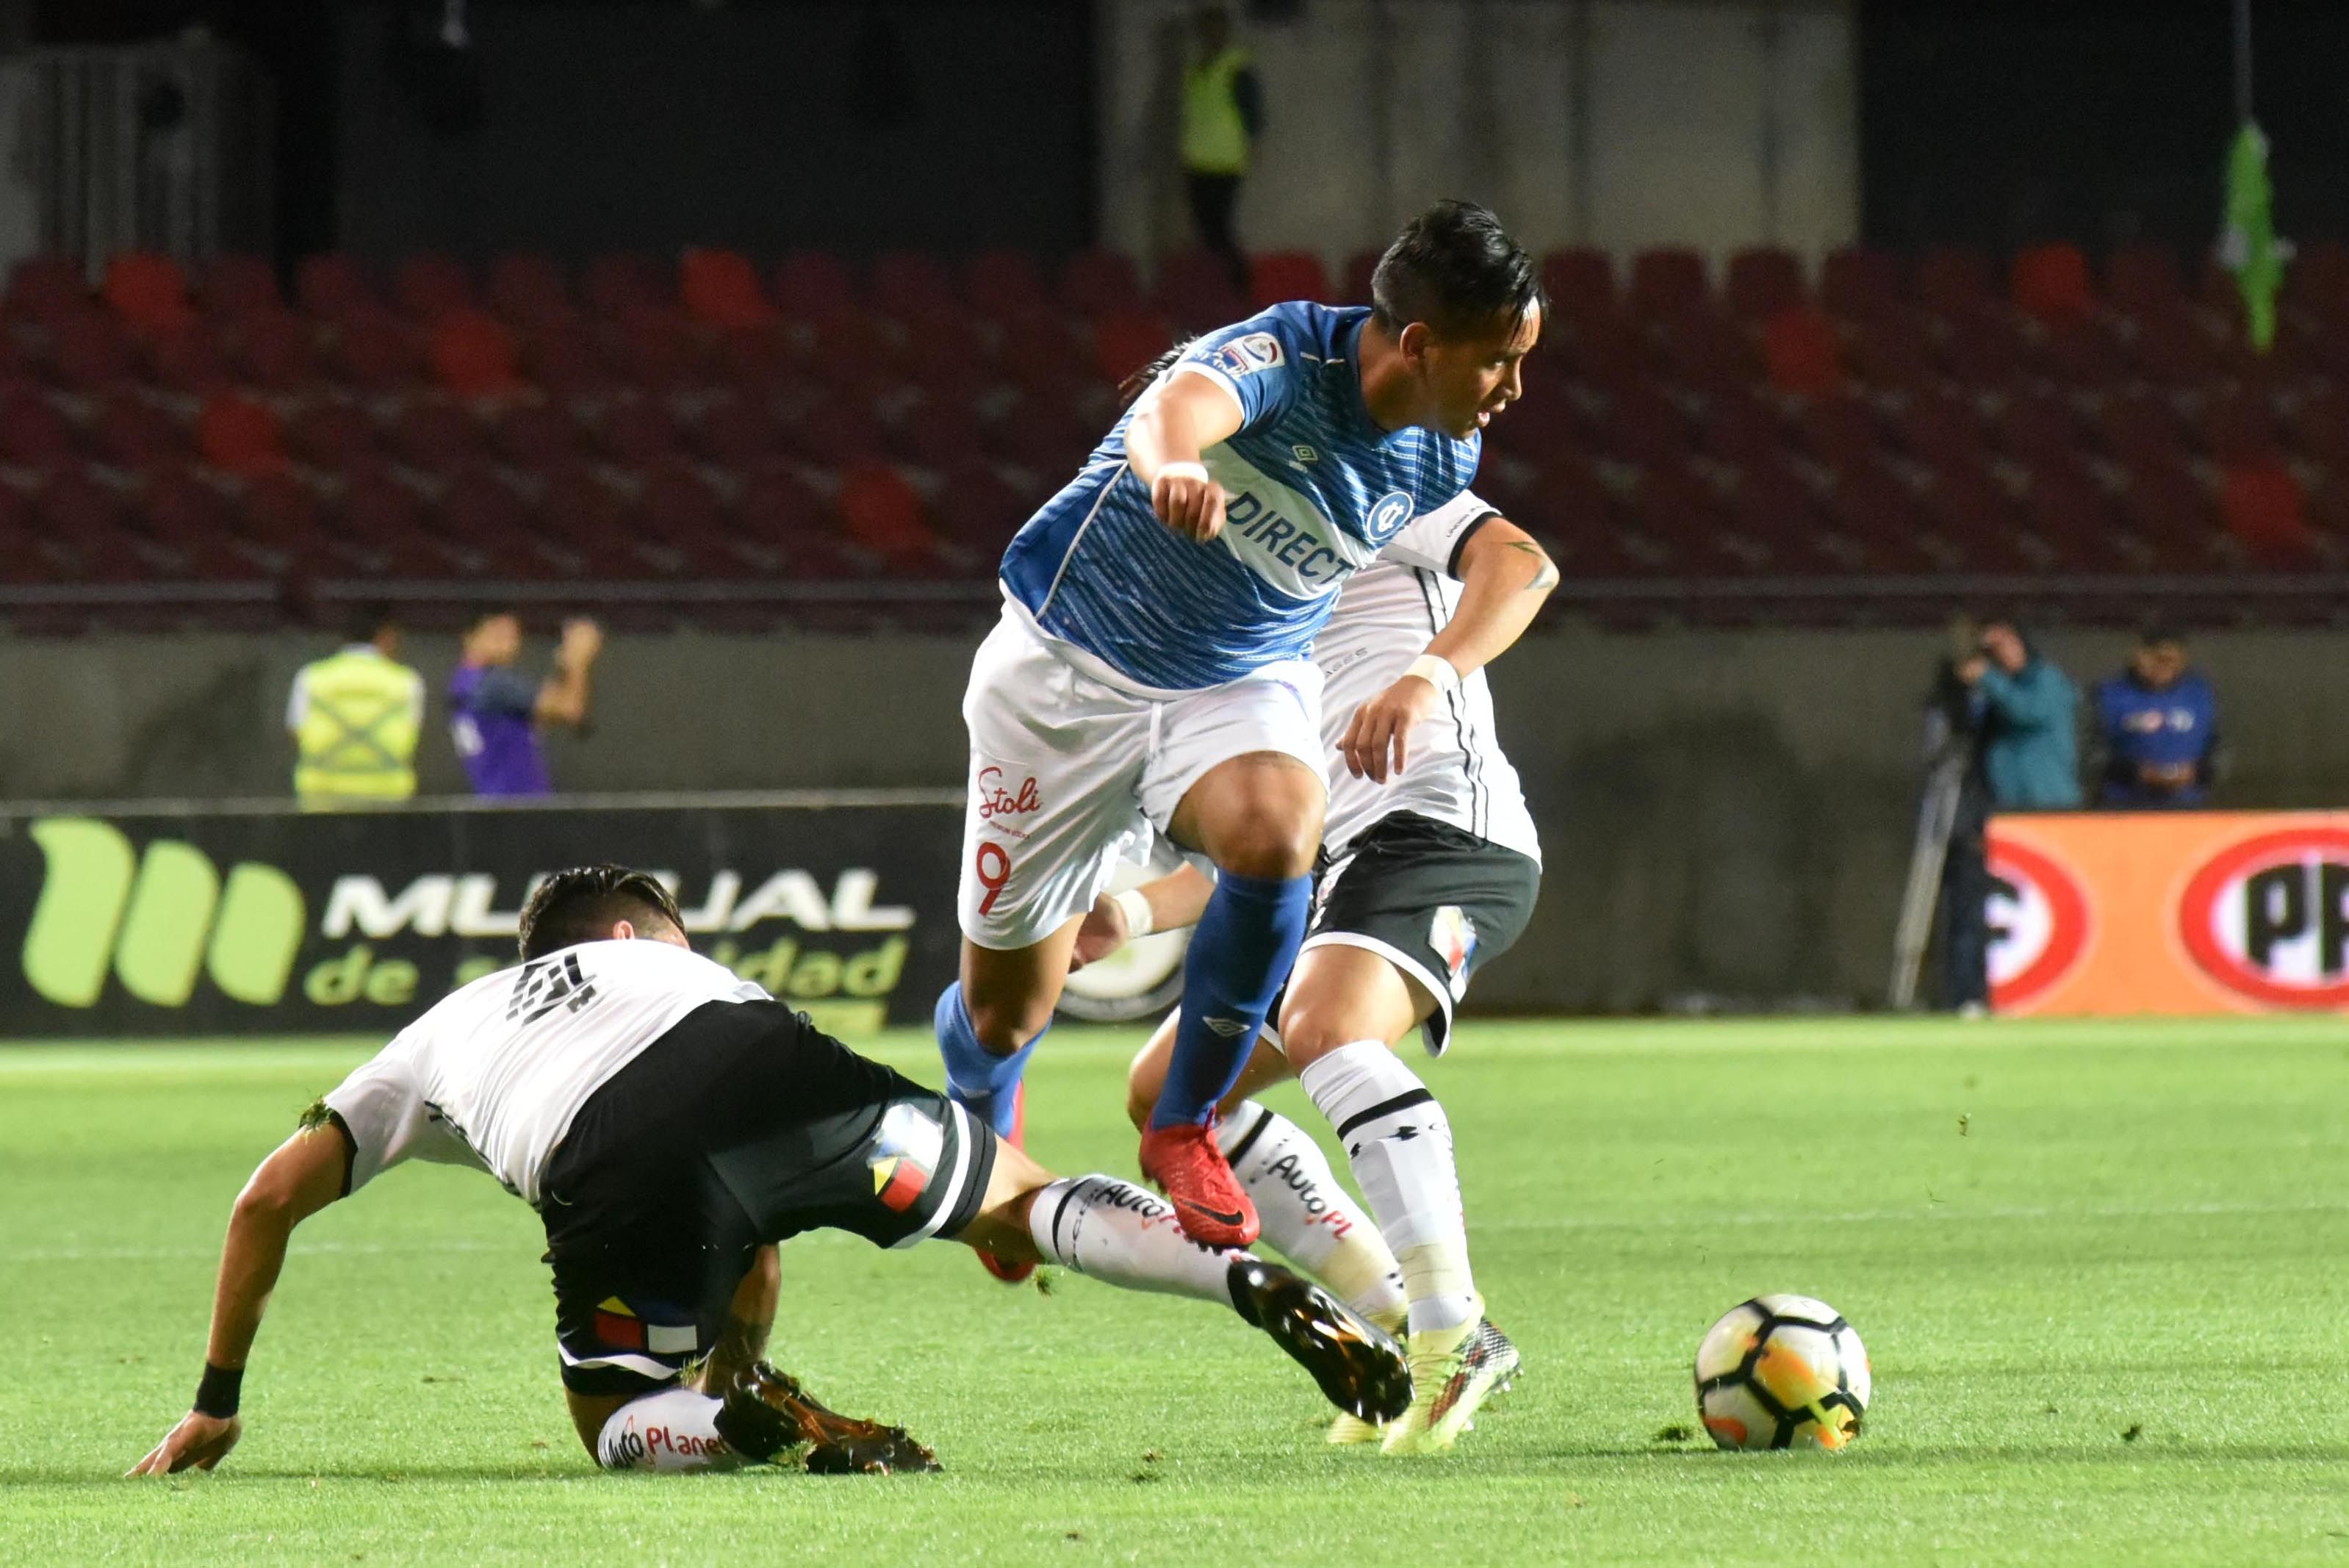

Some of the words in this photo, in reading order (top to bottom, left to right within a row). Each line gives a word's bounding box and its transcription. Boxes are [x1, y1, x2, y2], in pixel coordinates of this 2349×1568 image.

[979, 766, 1042, 819] Stoli
[322, 868, 916, 938] MUUAL
[976, 841, 1011, 917] 9
[303, 944, 420, 1005] de
